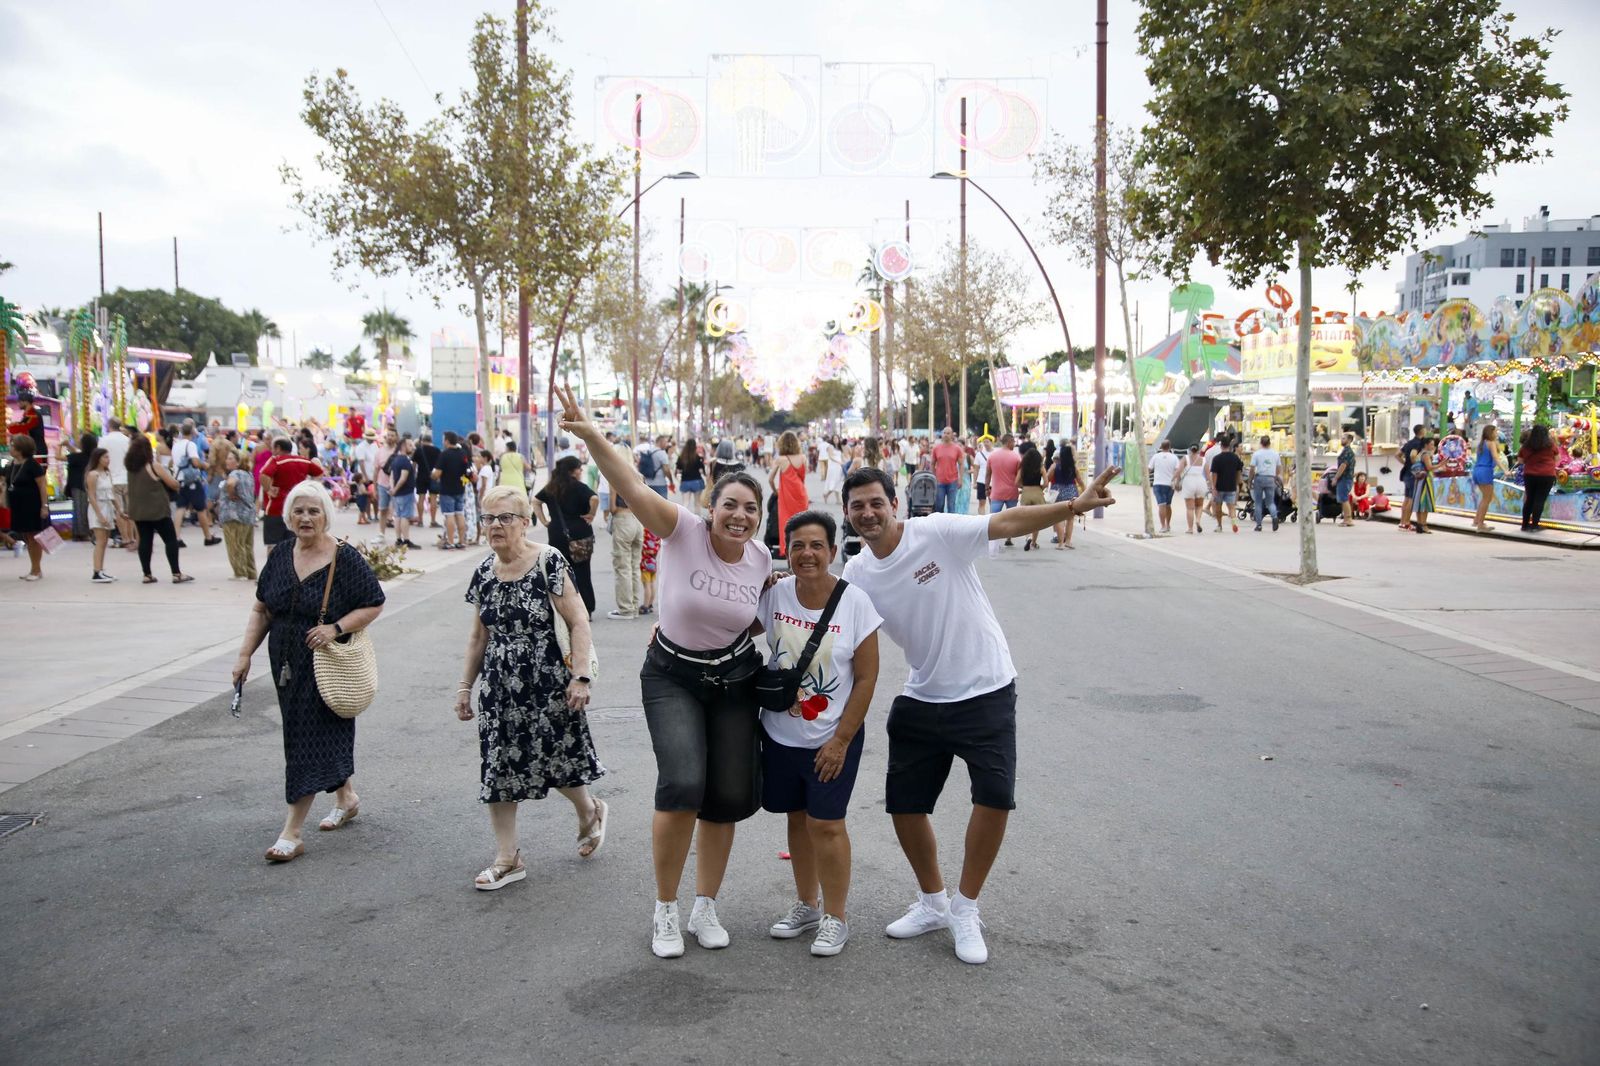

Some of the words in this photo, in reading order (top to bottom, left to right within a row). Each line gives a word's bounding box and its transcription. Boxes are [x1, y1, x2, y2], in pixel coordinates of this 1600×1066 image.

[689, 568, 759, 606] GUESS
[917, 566, 940, 585] JONES
[773, 611, 802, 628] TUTTI
[803, 621, 841, 634] FRTI
